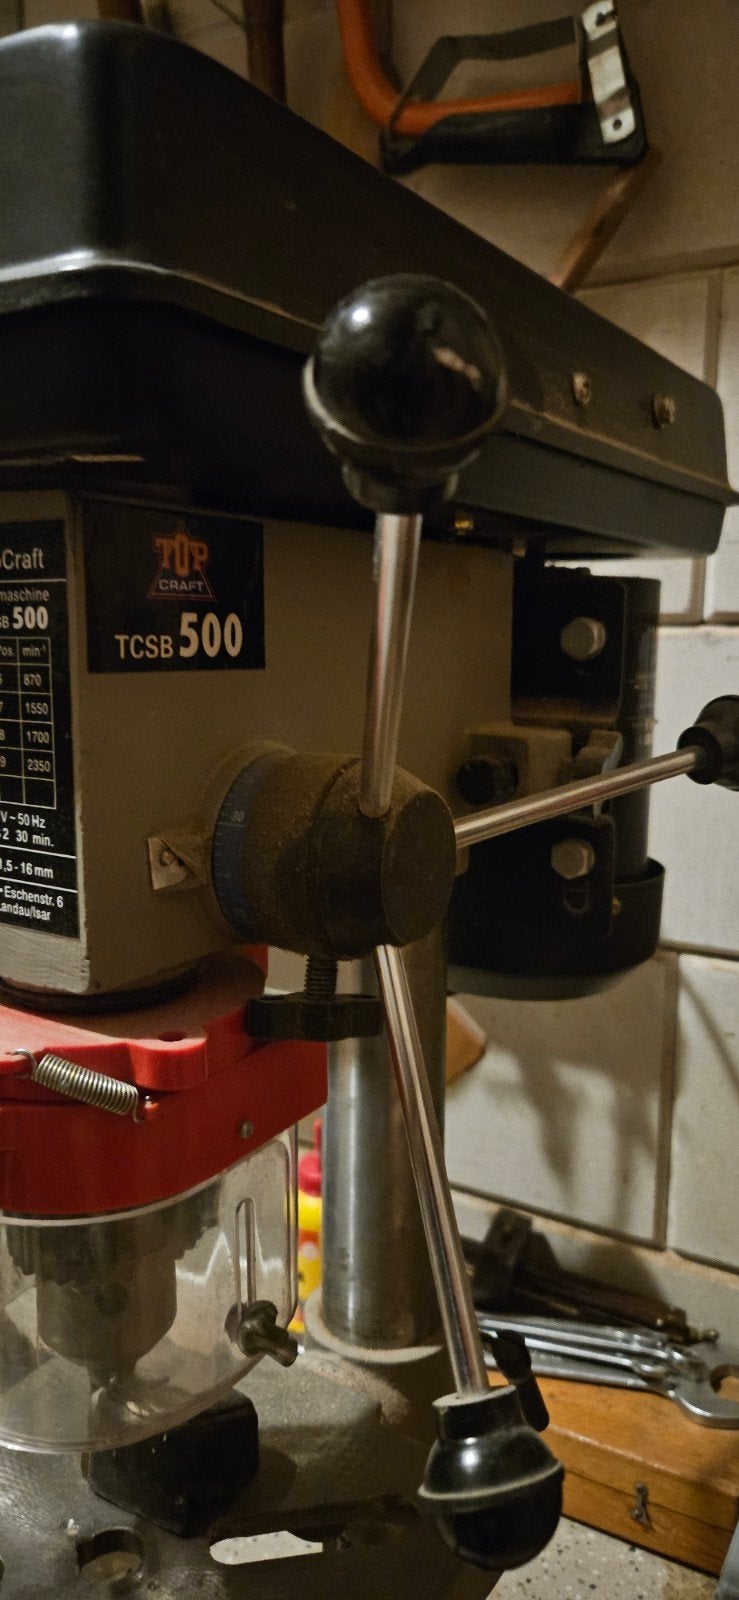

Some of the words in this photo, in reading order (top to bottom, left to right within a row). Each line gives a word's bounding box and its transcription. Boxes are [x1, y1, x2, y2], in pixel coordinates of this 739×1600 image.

[0, 547, 45, 570] Craft
[153, 531, 208, 576] TOP
[158, 579, 205, 592] CRAFT
[12, 605, 49, 630] 500
[114, 634, 174, 659] TCSB
[179, 611, 243, 658] 500
[23, 674, 41, 686] 870
[25, 702, 49, 715] 1550
[26, 730, 50, 744] 1700
[27, 758, 51, 773] 2350
[31, 814, 47, 829] Hz
[15, 829, 29, 843] 30
[32, 832, 55, 847] min.
[34, 866, 54, 879] mm
[4, 885, 55, 907] Eschenstr.
[56, 895, 64, 908] 6
[0, 902, 51, 921] andau/Isar
